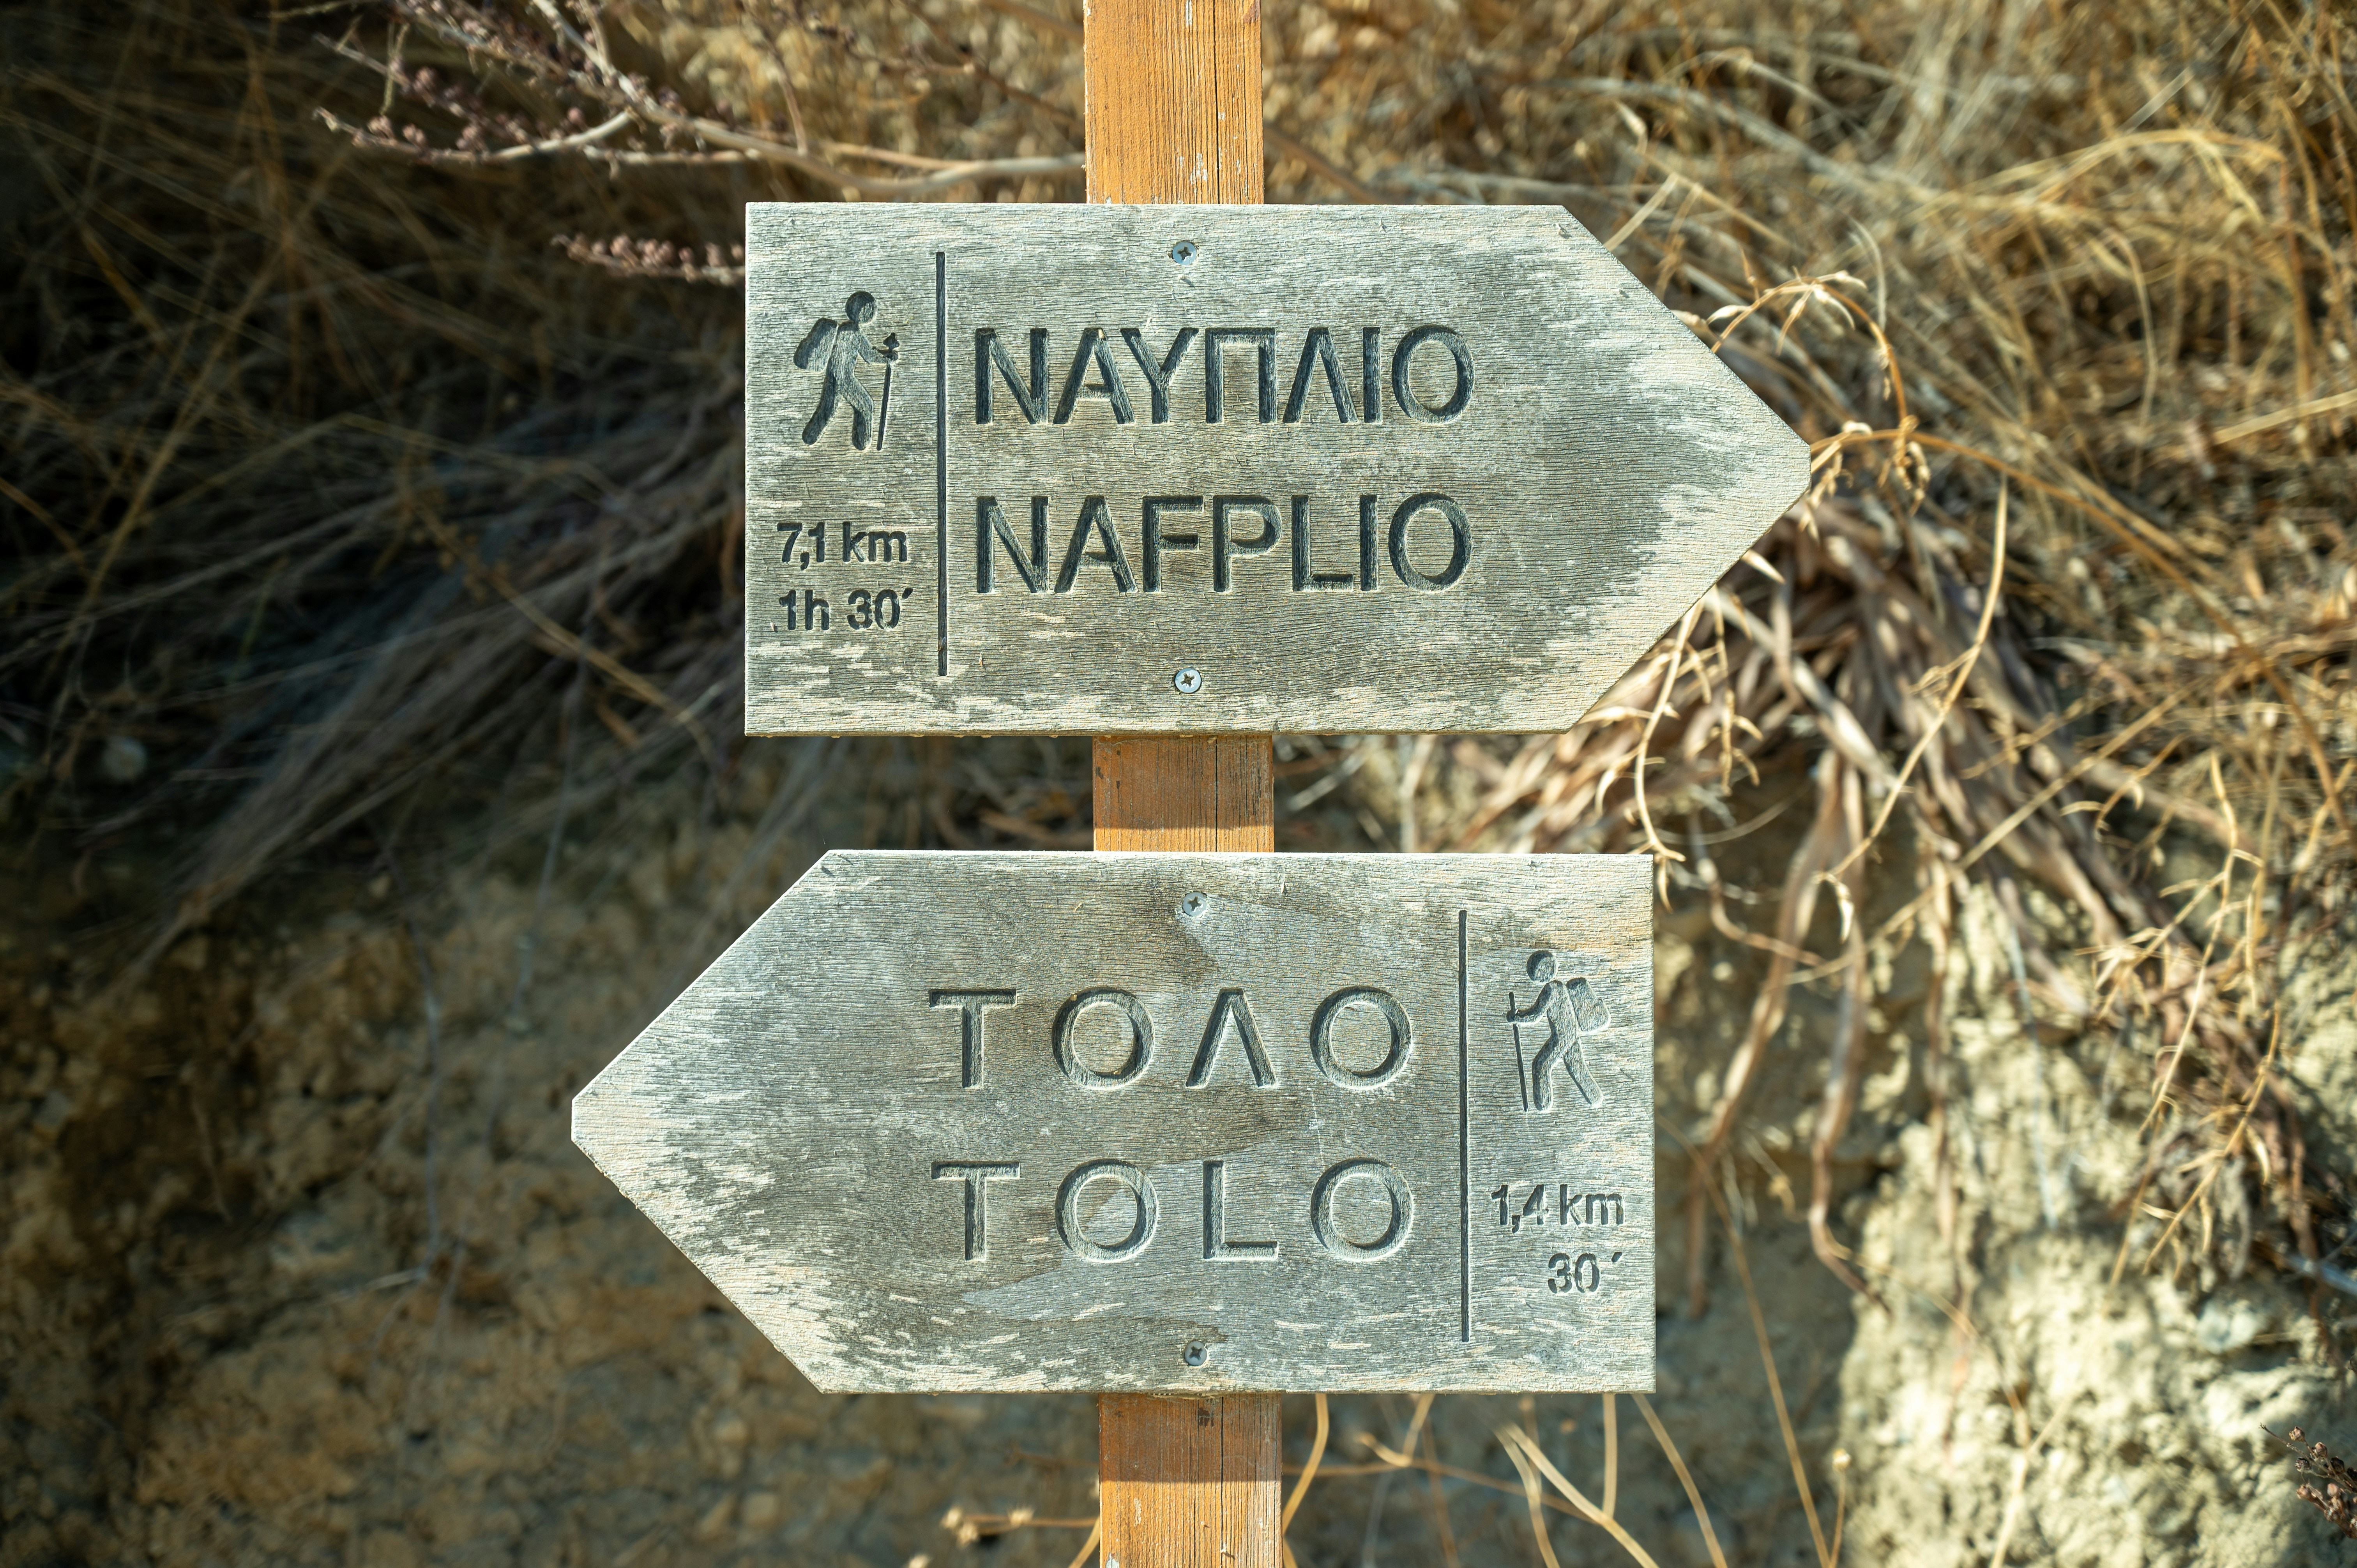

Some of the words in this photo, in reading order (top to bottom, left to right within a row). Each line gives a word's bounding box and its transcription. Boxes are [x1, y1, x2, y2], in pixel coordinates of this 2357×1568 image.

[975, 324, 1475, 425] ΝΑΥΠΛΙΟ
[777, 521, 825, 570] 7,1
[842, 521, 908, 562] km
[976, 492, 1472, 593] NAFPLIO
[779, 589, 830, 630] 1h
[929, 985, 1413, 1090] ΤΟΛΟ
[931, 1158, 1414, 1262] TOLO
[1491, 1184, 1549, 1233] 1,4
[1559, 1184, 1625, 1226] km
